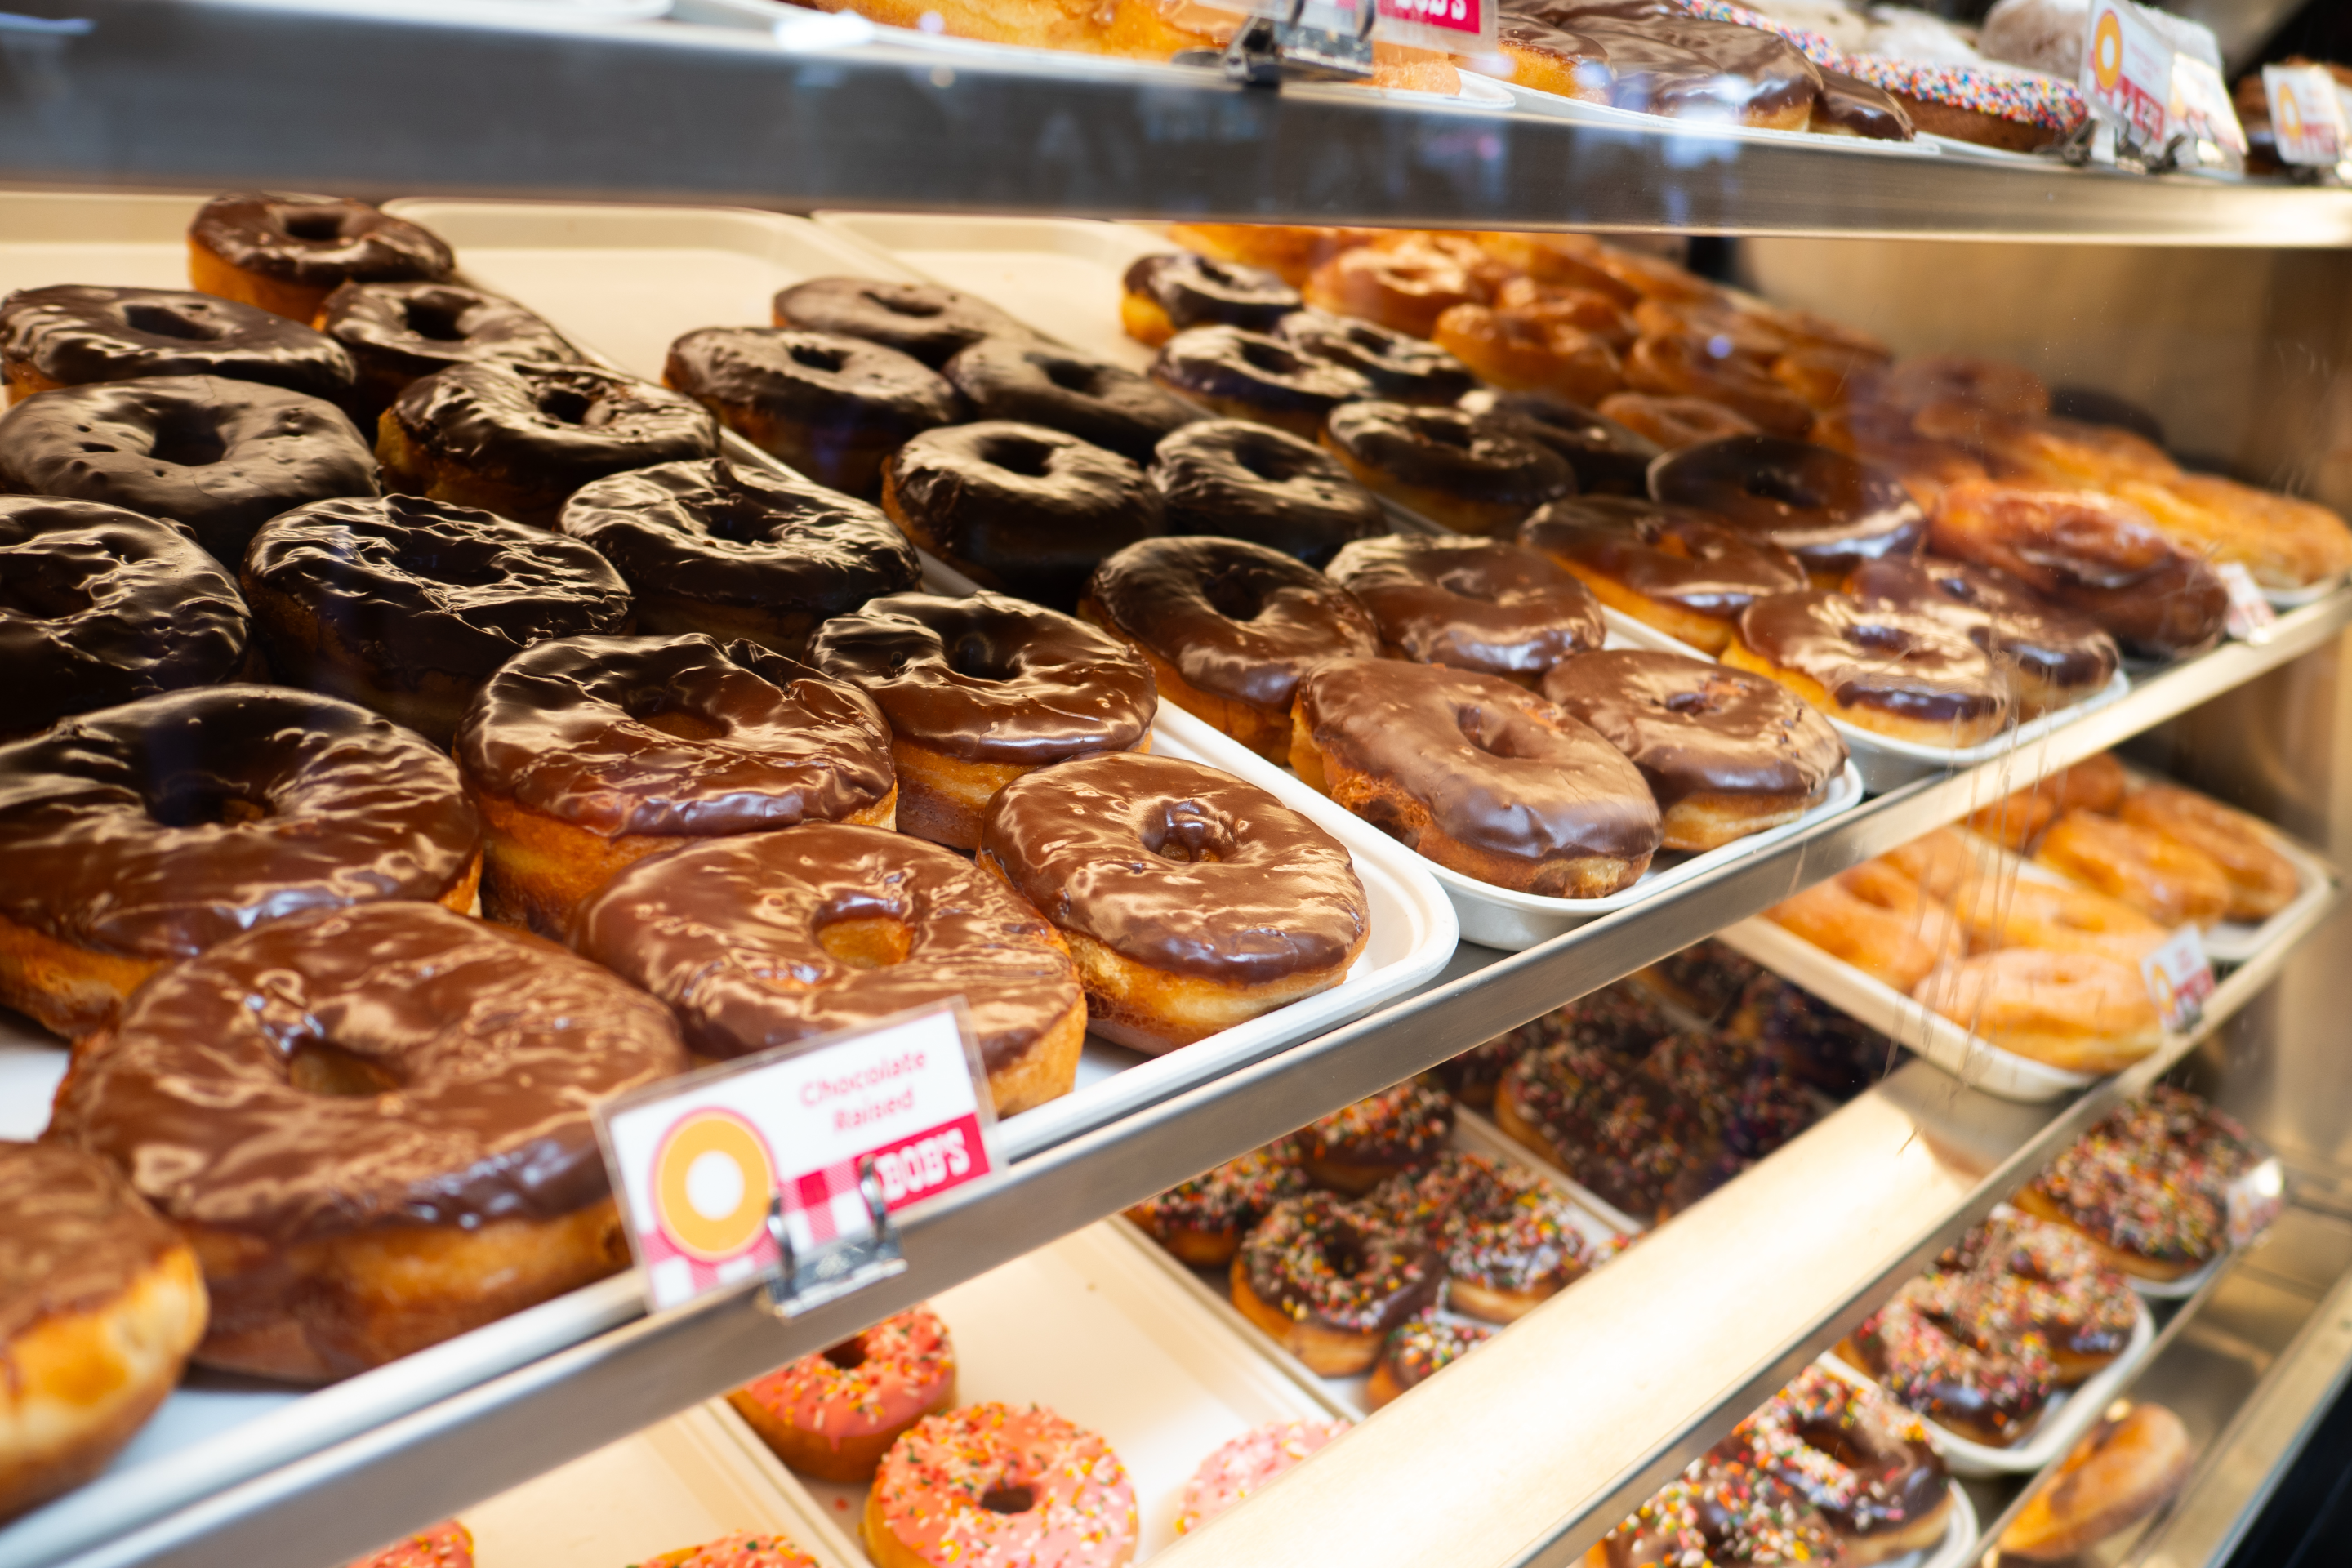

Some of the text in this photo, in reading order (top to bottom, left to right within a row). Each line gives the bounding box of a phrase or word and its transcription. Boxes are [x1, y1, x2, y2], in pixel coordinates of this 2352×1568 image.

[800, 1051, 926, 1107] Chocolate
[834, 1088, 914, 1133] Raised
[875, 1126, 971, 1202] BOB'S
